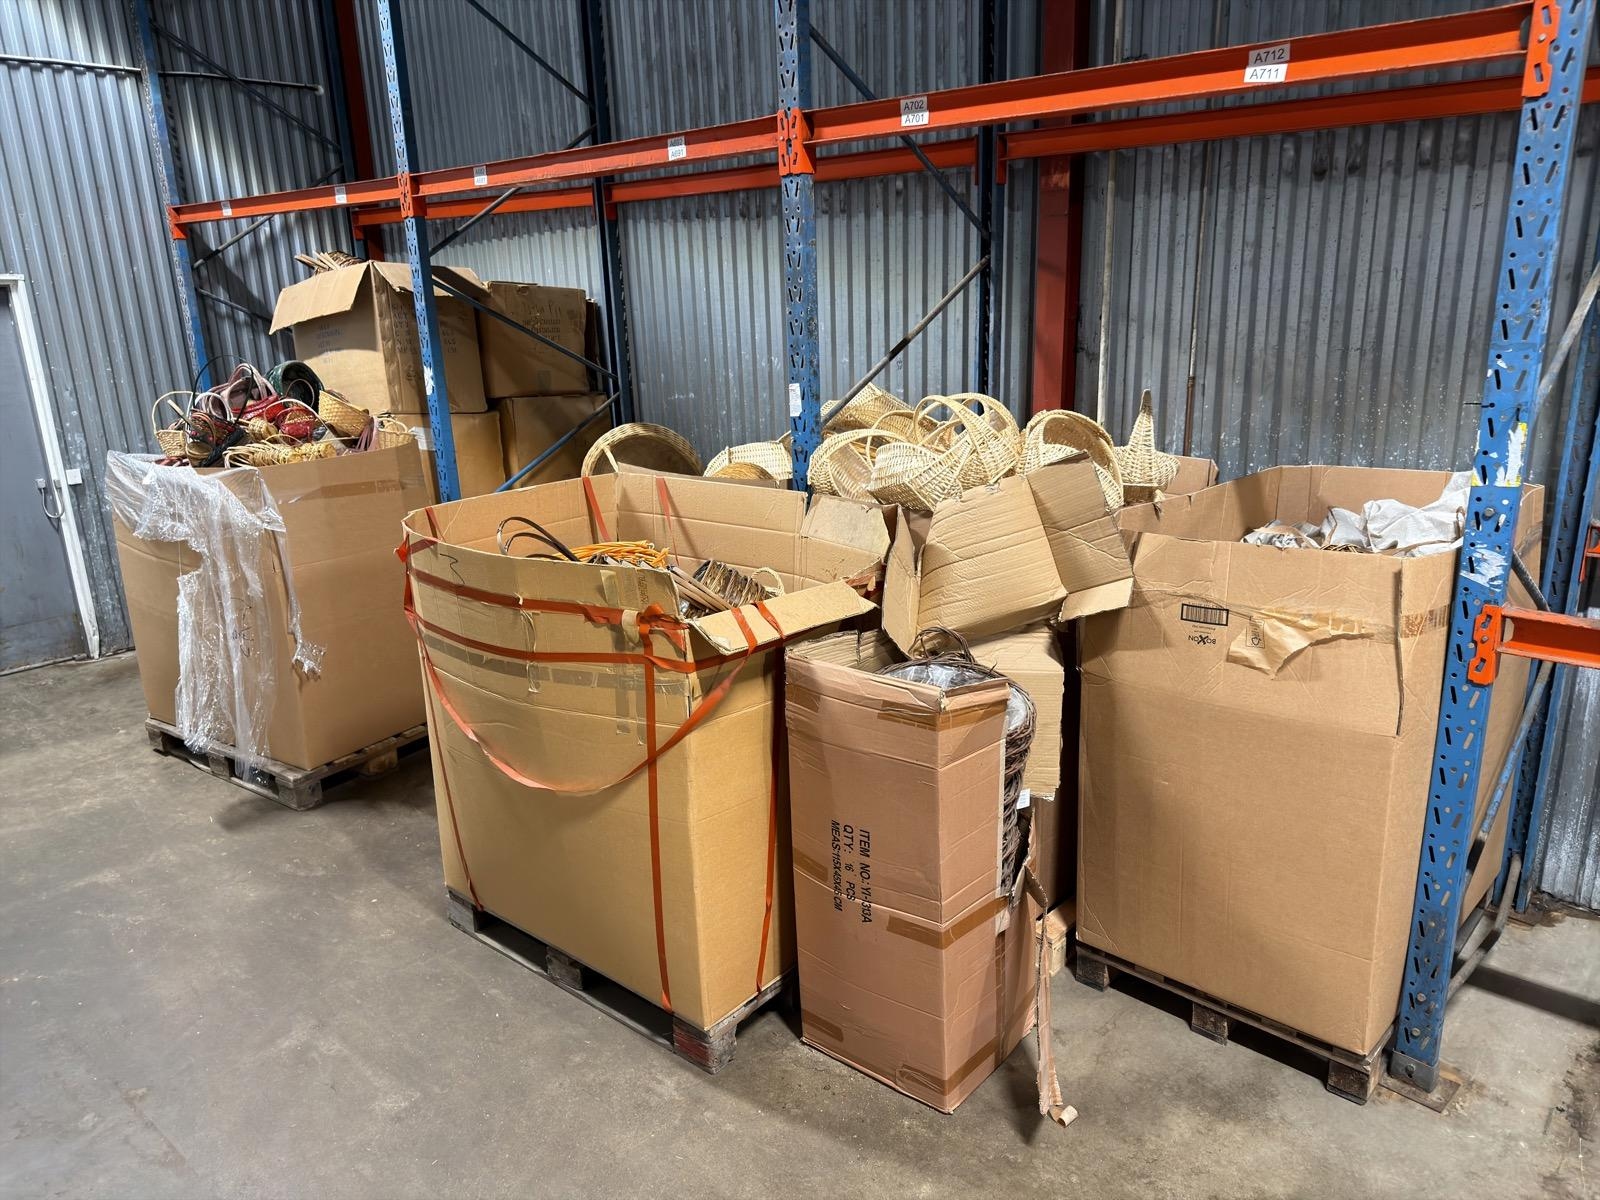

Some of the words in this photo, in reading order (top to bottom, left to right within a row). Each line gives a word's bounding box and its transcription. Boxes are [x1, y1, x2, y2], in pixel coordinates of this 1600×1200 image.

[1254, 48, 1285, 64] A712
[1249, 68, 1279, 80] A711
[904, 100, 924, 111] A702
[904, 114, 924, 124] A701
[1188, 634, 1217, 645] BOXON
[843, 824, 854, 854] QTY:
[859, 829, 870, 858] ITEM
[846, 880, 856, 901] PCS
[834, 896, 843, 912] CM
